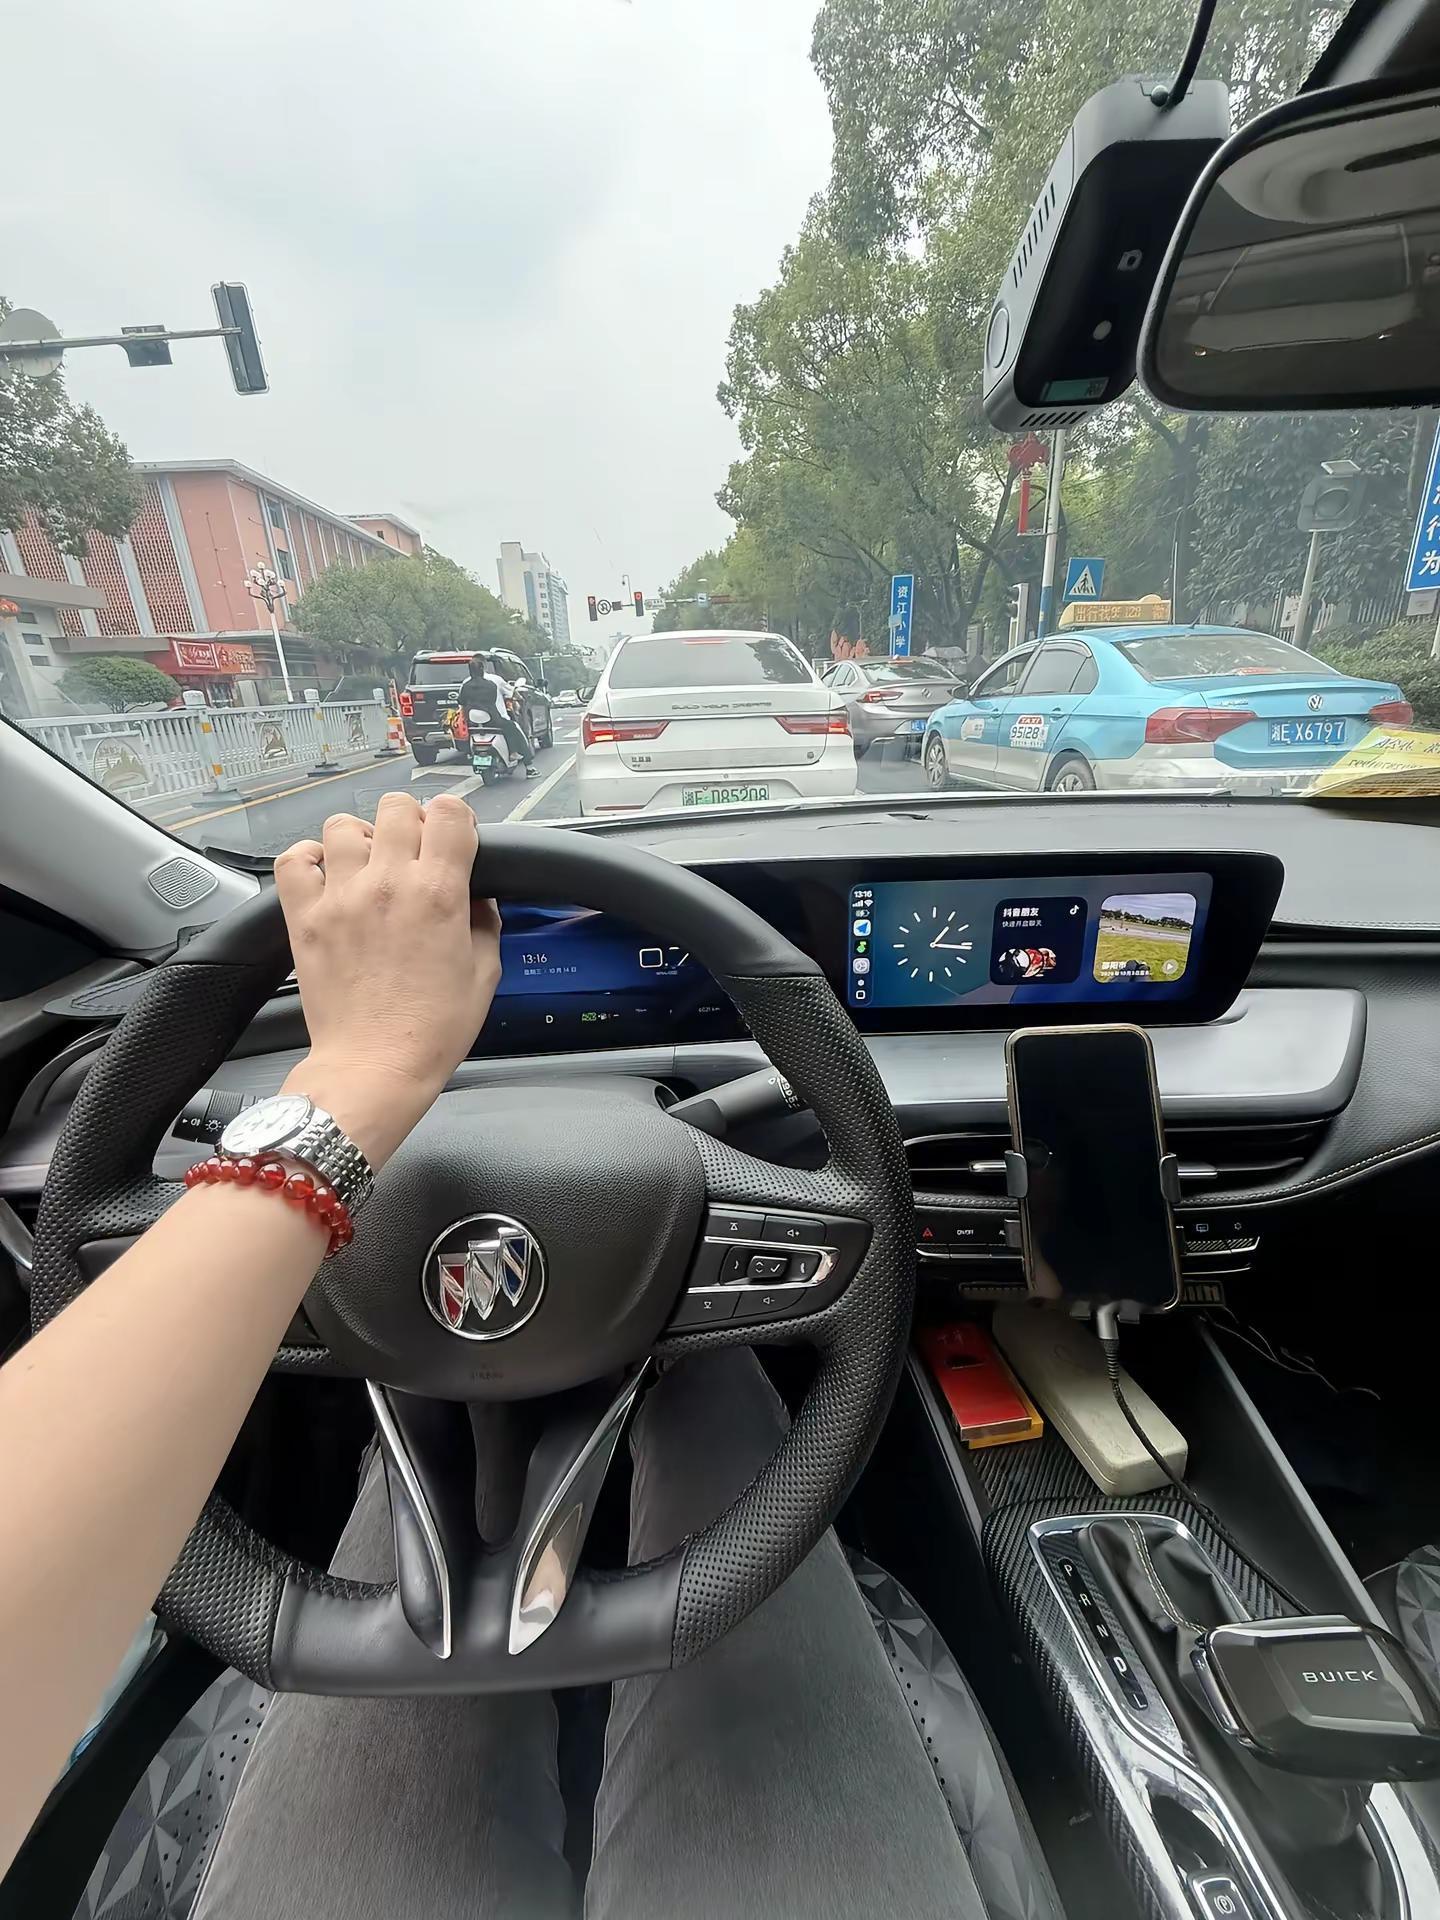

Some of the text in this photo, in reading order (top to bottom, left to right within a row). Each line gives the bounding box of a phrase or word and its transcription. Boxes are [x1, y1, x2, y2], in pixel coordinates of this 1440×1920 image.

[1011, 726, 1040, 739] 95128
[854, 890, 873, 898] 13:16
[522, 953, 548, 964] 13:16
[545, 1014, 554, 1023] D
[1063, 1563, 1147, 1709] P R N D L
[1302, 1669, 1378, 1684] BUICK
